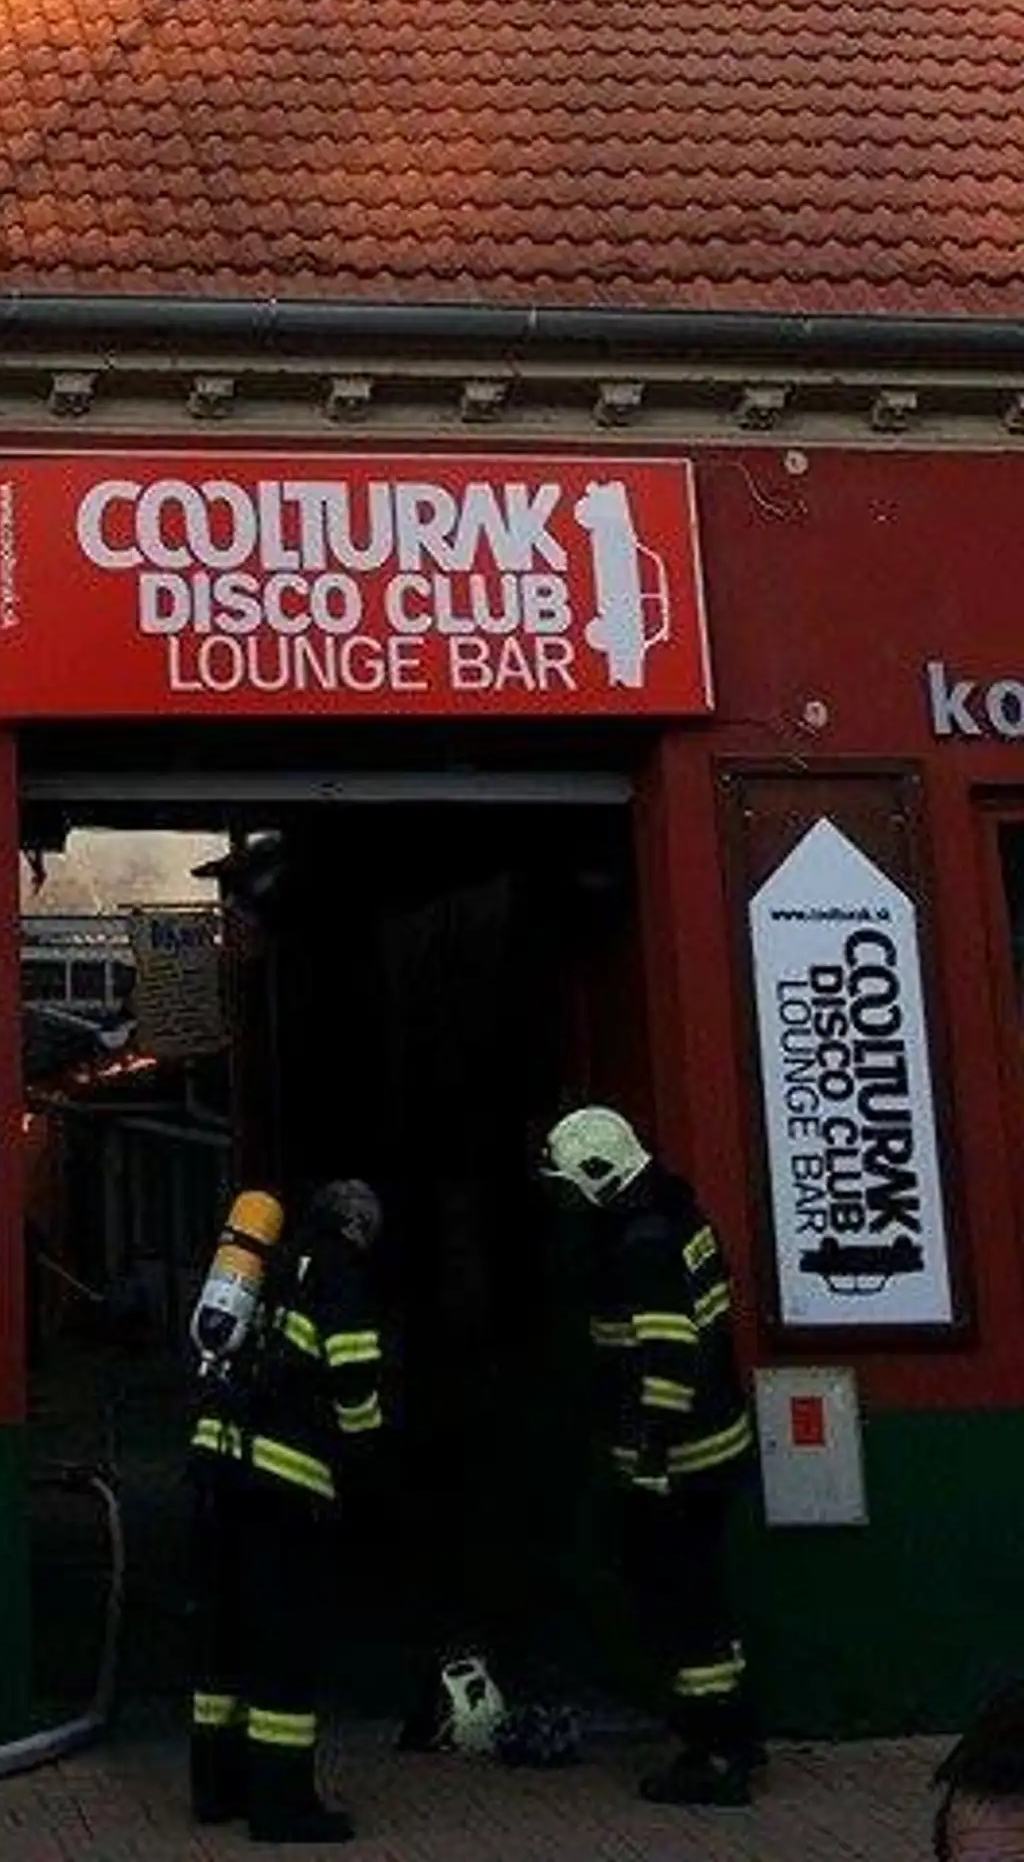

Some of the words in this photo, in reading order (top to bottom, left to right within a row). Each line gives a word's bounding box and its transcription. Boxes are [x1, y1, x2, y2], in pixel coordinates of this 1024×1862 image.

[76, 479, 568, 571] COOLTURAK
[138, 572, 363, 634] DISCO
[385, 574, 571, 635] CLUB
[167, 637, 429, 692] LOUNGE
[450, 637, 578, 691] BAR
[777, 980, 821, 1141] LOUNGE
[810, 964, 856, 1103] DISCO
[844, 929, 922, 1235] COOLTURAK
[791, 1154, 829, 1236] BAR
[822, 1117, 866, 1234] CLUB
